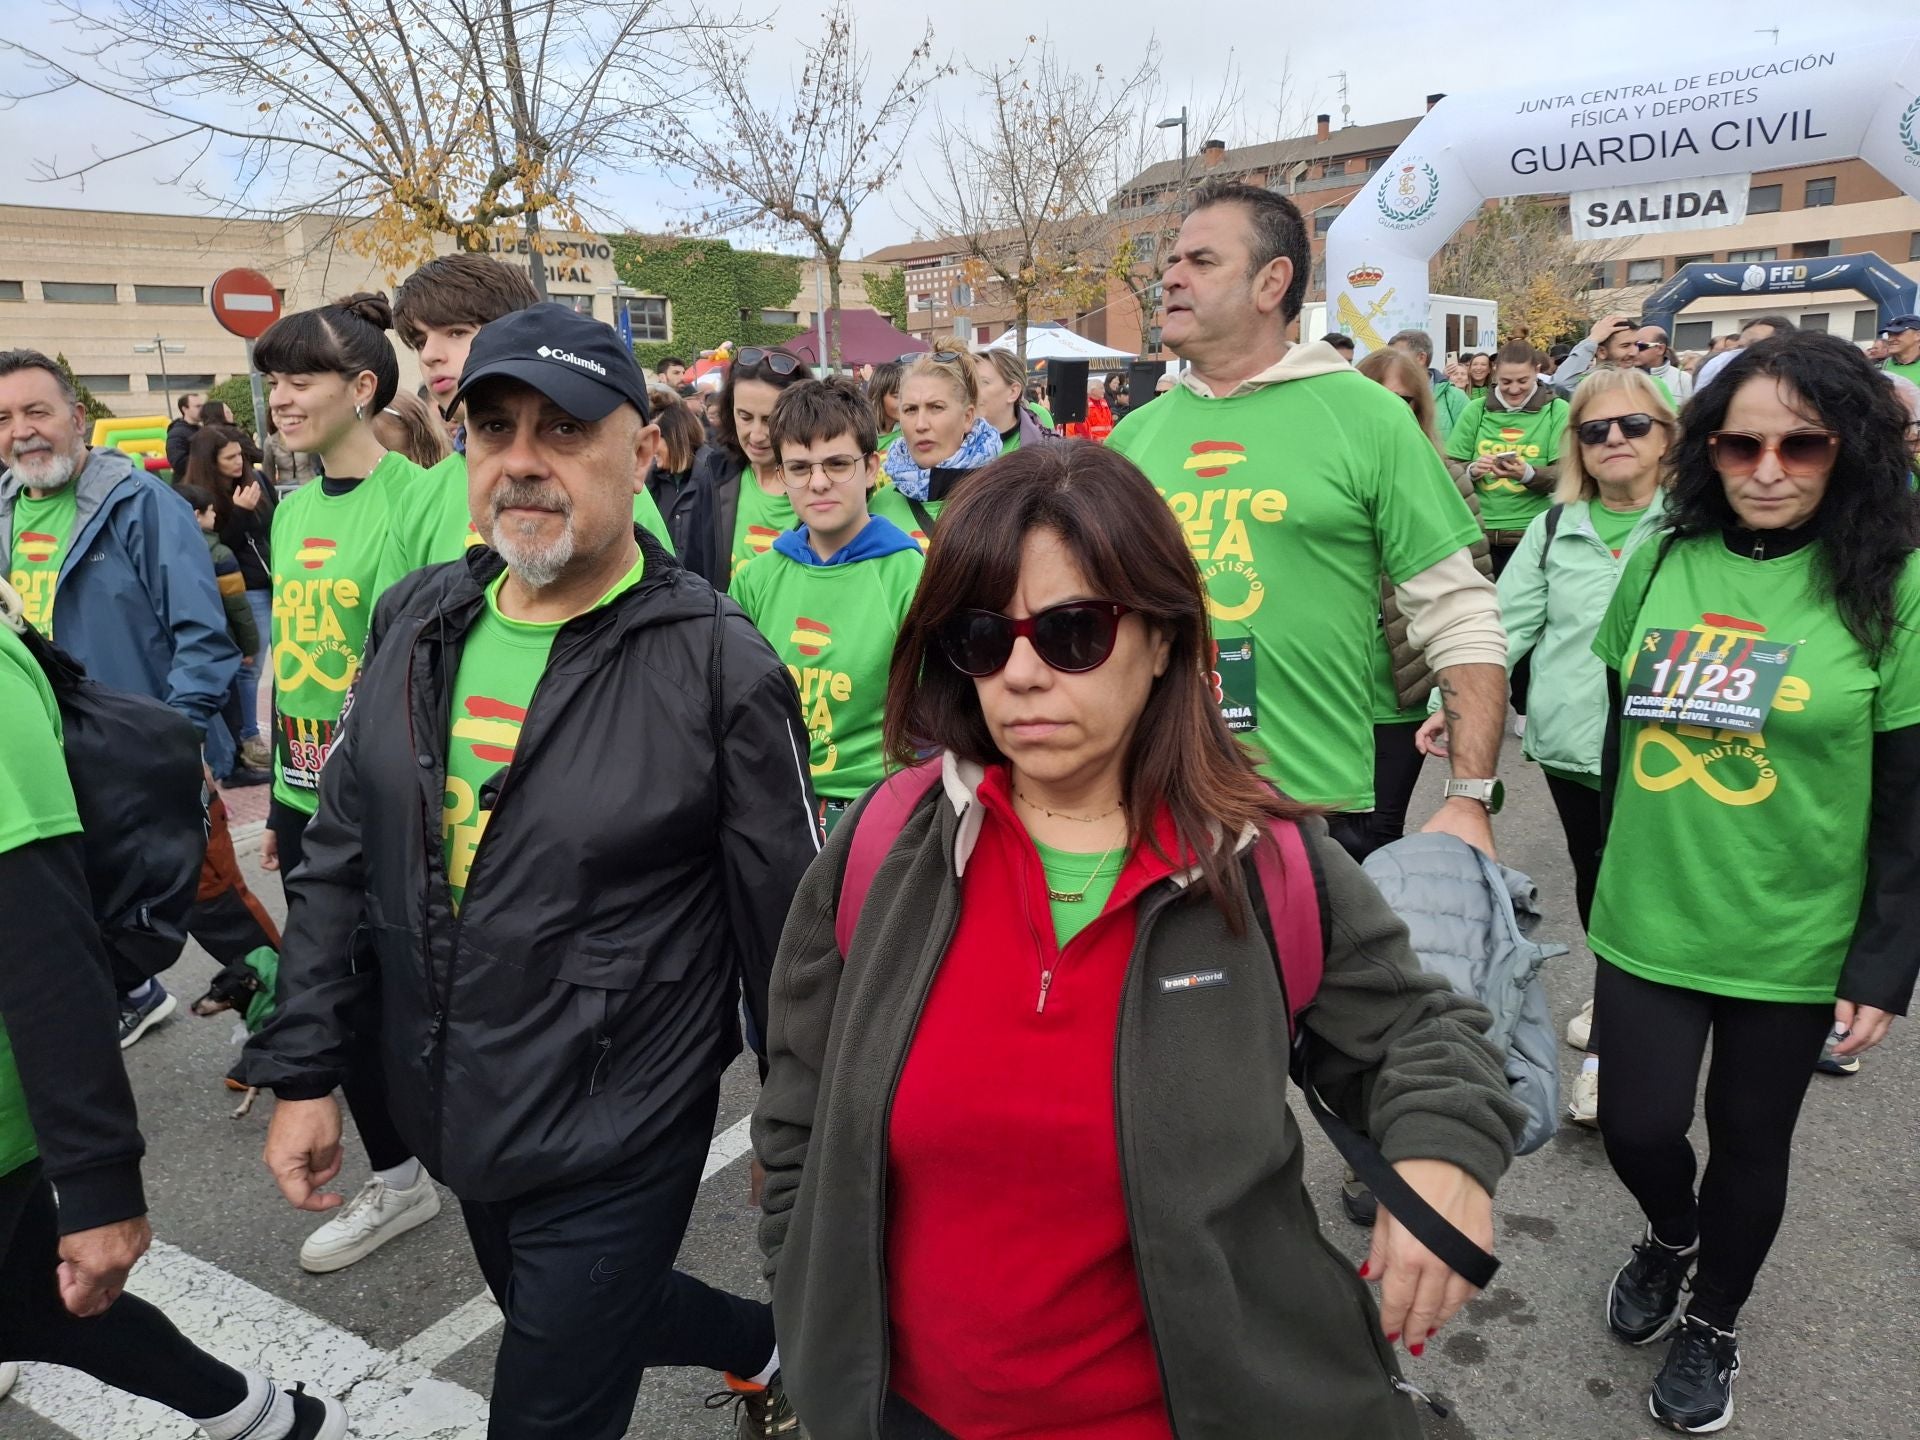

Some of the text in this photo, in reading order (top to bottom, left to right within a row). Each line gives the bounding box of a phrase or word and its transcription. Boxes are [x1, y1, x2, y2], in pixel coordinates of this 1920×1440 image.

[1516, 52, 1835, 115] JUNTA CENTRAL DE EDUCACIÓN
[1570, 87, 1759, 128] FÍSICA Y DEPORTES
[1511, 109, 1828, 175] GUARDIA CIVIL
[1378, 212, 1438, 230] GUARDIA CIVIL
[1586, 189, 1728, 228] SALIDA
[551, 348, 606, 376] Columbia
[1155, 487, 1288, 523] orre
[1180, 518, 1254, 562] EA
[273, 604, 347, 642] TEA
[310, 640, 358, 664] AUTISMO
[1651, 658, 1757, 702] 1123
[1629, 708, 1677, 719] GUARDIA
[1678, 711, 1710, 722] CIVIL
[1631, 695, 1761, 719] CARRERA SOLIDARIA
[1703, 744, 1775, 779] AUTISMO
